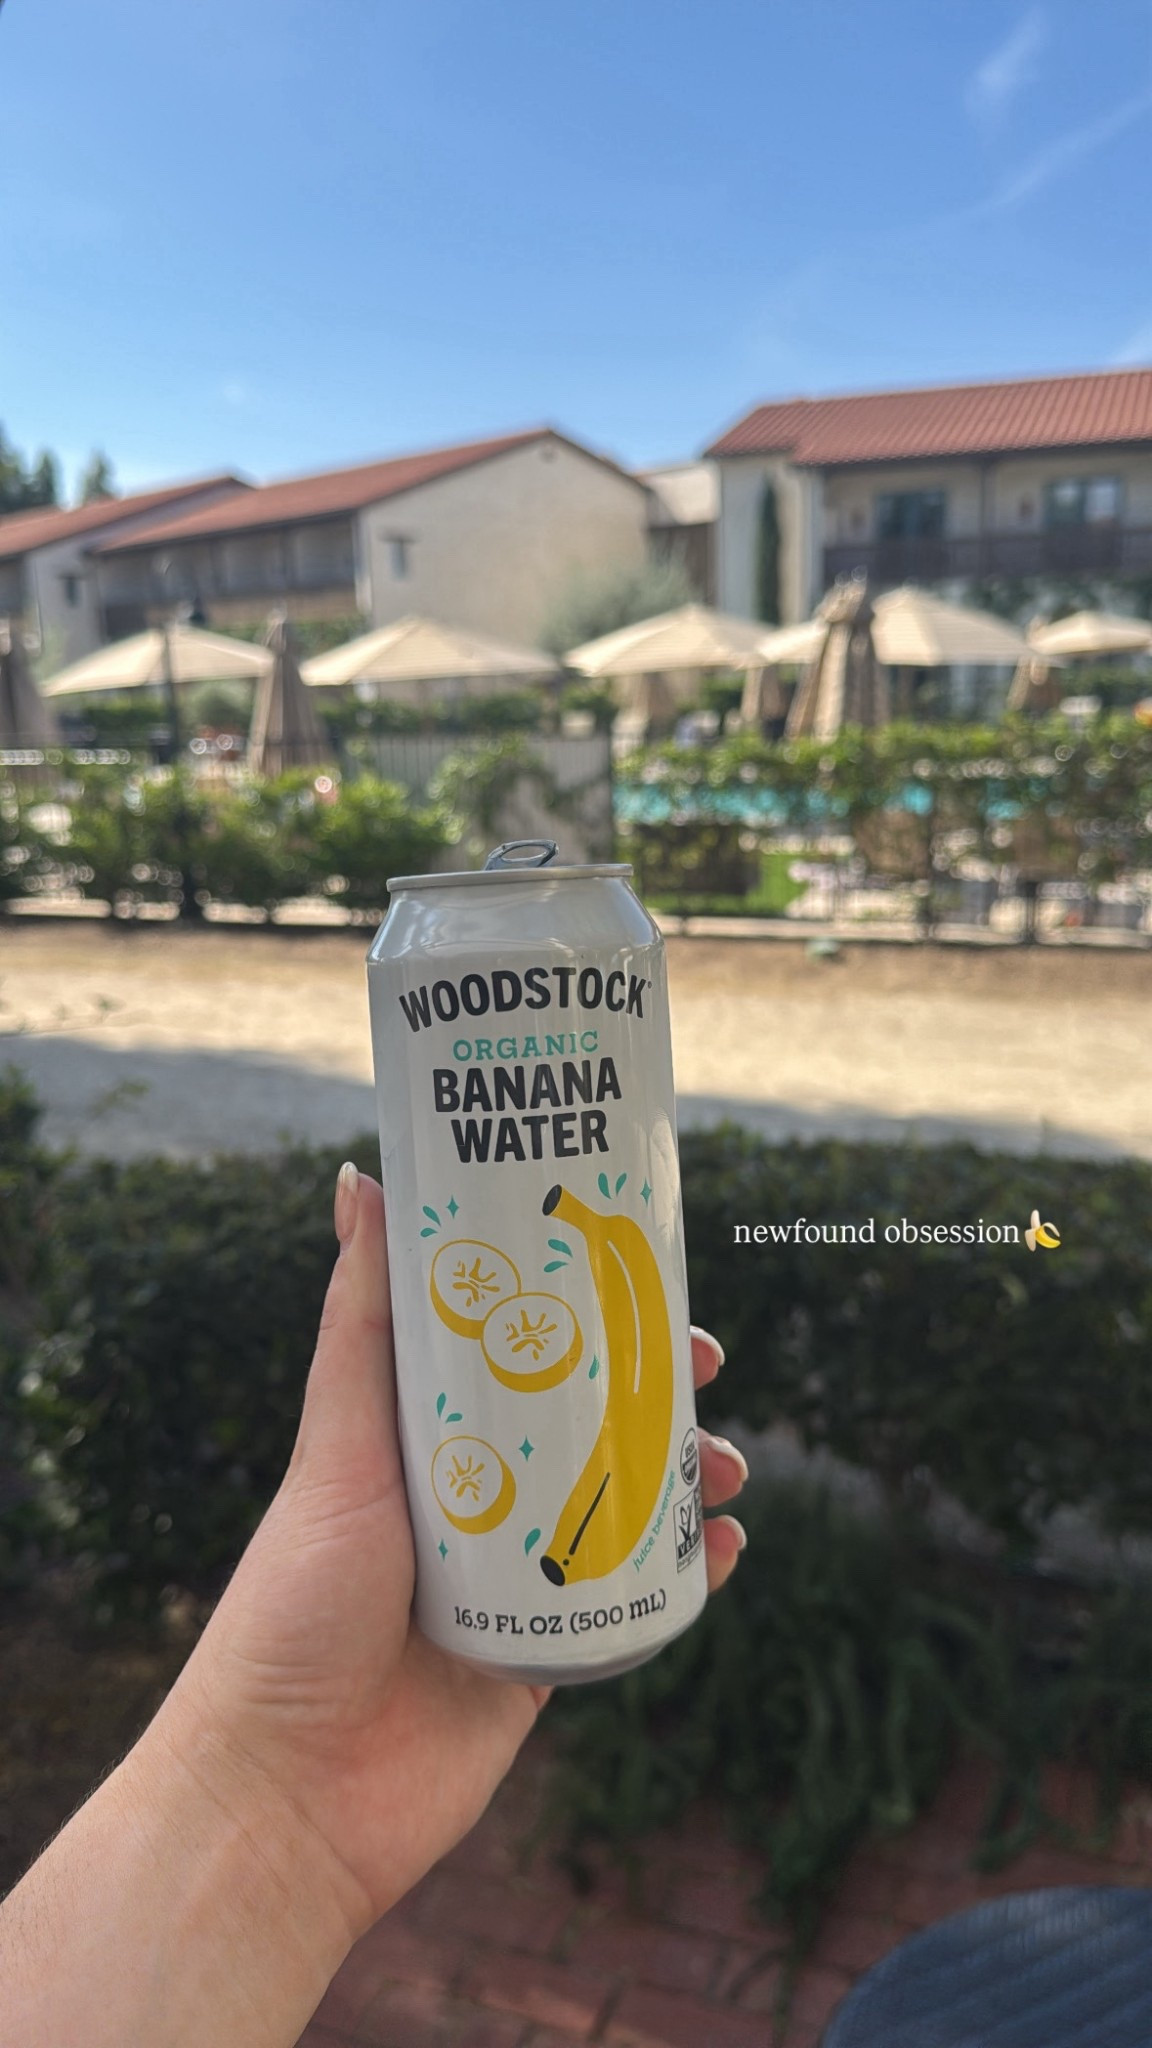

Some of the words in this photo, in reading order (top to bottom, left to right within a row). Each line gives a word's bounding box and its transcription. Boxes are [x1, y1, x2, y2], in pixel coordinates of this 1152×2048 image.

[399, 967, 645, 1032] WOODSTOCK
[452, 1030, 599, 1061] ORGANIC
[432, 1057, 622, 1112] BANANA
[451, 1109, 610, 1163] WATER
[632, 1536, 655, 1573] juice
[652, 1470, 676, 1536] beverage
[454, 1606, 489, 1631] 16.9
[495, 1614, 524, 1635] FL
[529, 1615, 564, 1635] OZ
[570, 1605, 624, 1635] (500
[629, 1588, 667, 1620] mL)
